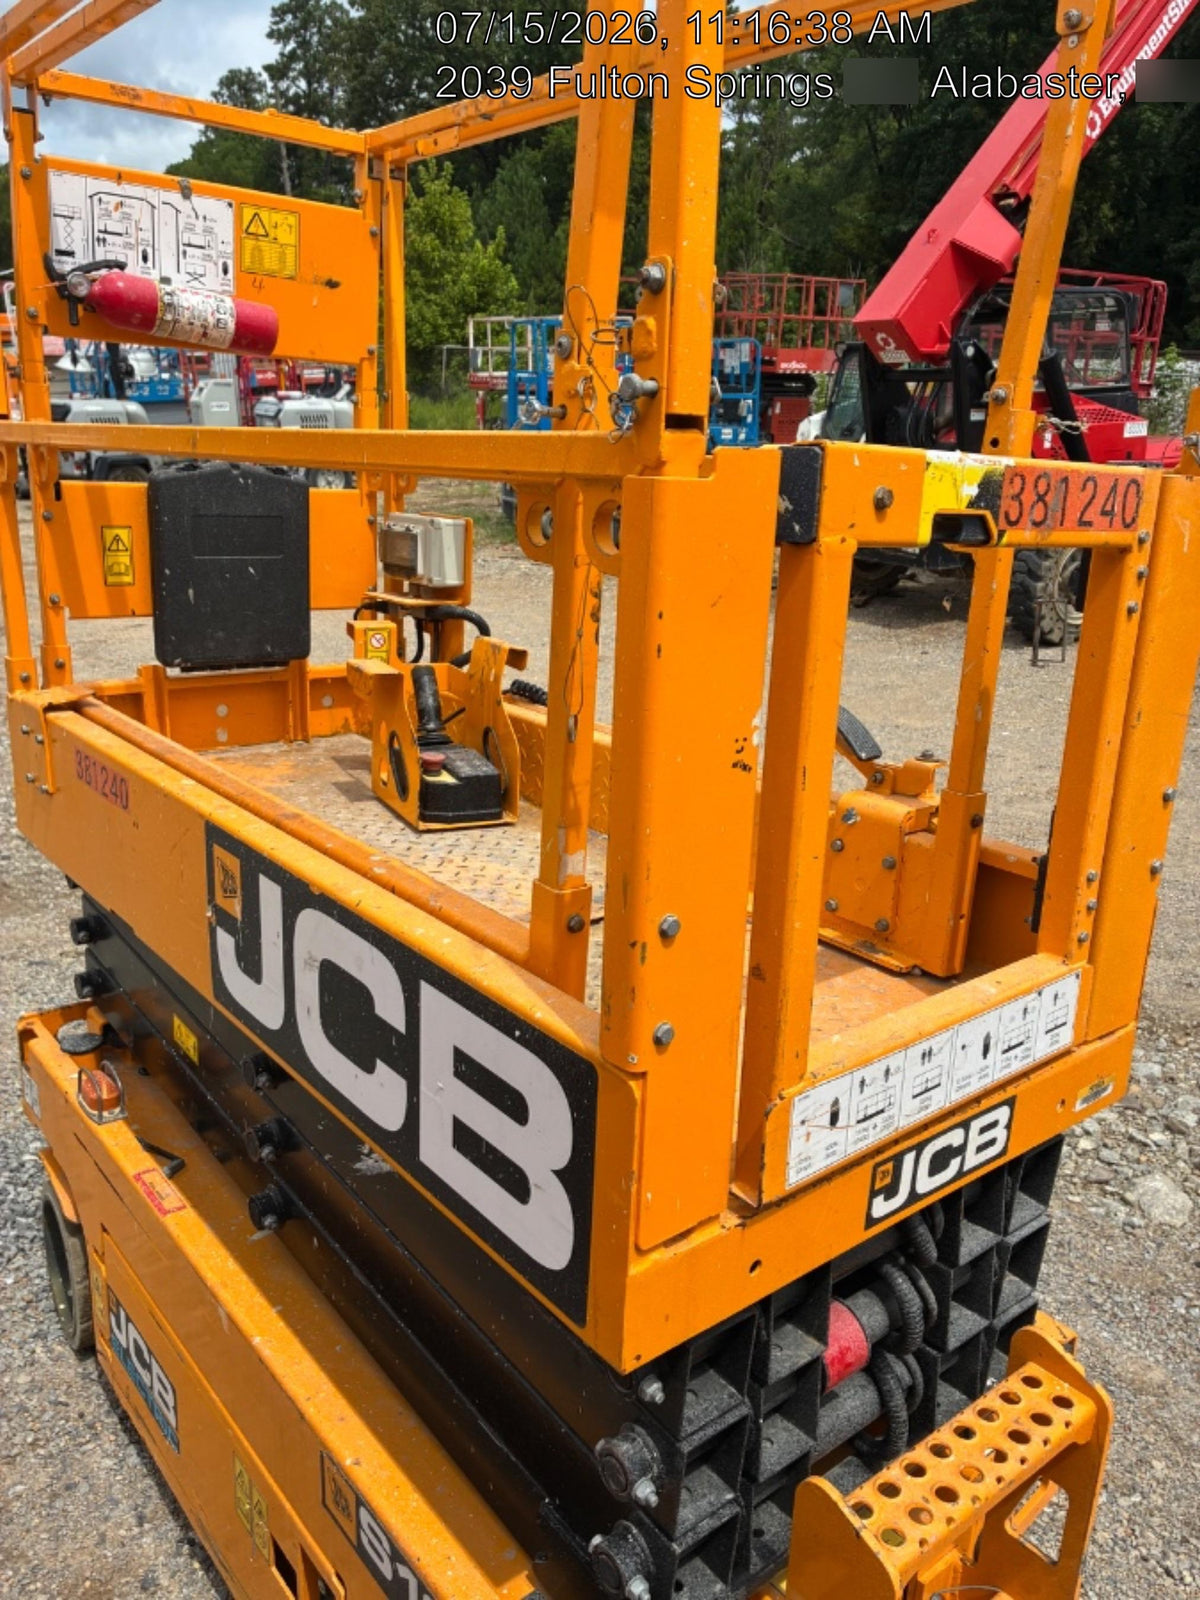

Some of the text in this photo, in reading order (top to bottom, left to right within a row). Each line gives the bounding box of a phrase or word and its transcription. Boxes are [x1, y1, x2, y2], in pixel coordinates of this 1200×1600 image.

[1004, 471, 1142, 529] 381240
[76, 749, 129, 810] 381240
[216, 873, 574, 1271] JCB
[870, 1104, 1011, 1219] JCB
[110, 1306, 177, 1430] JCB
